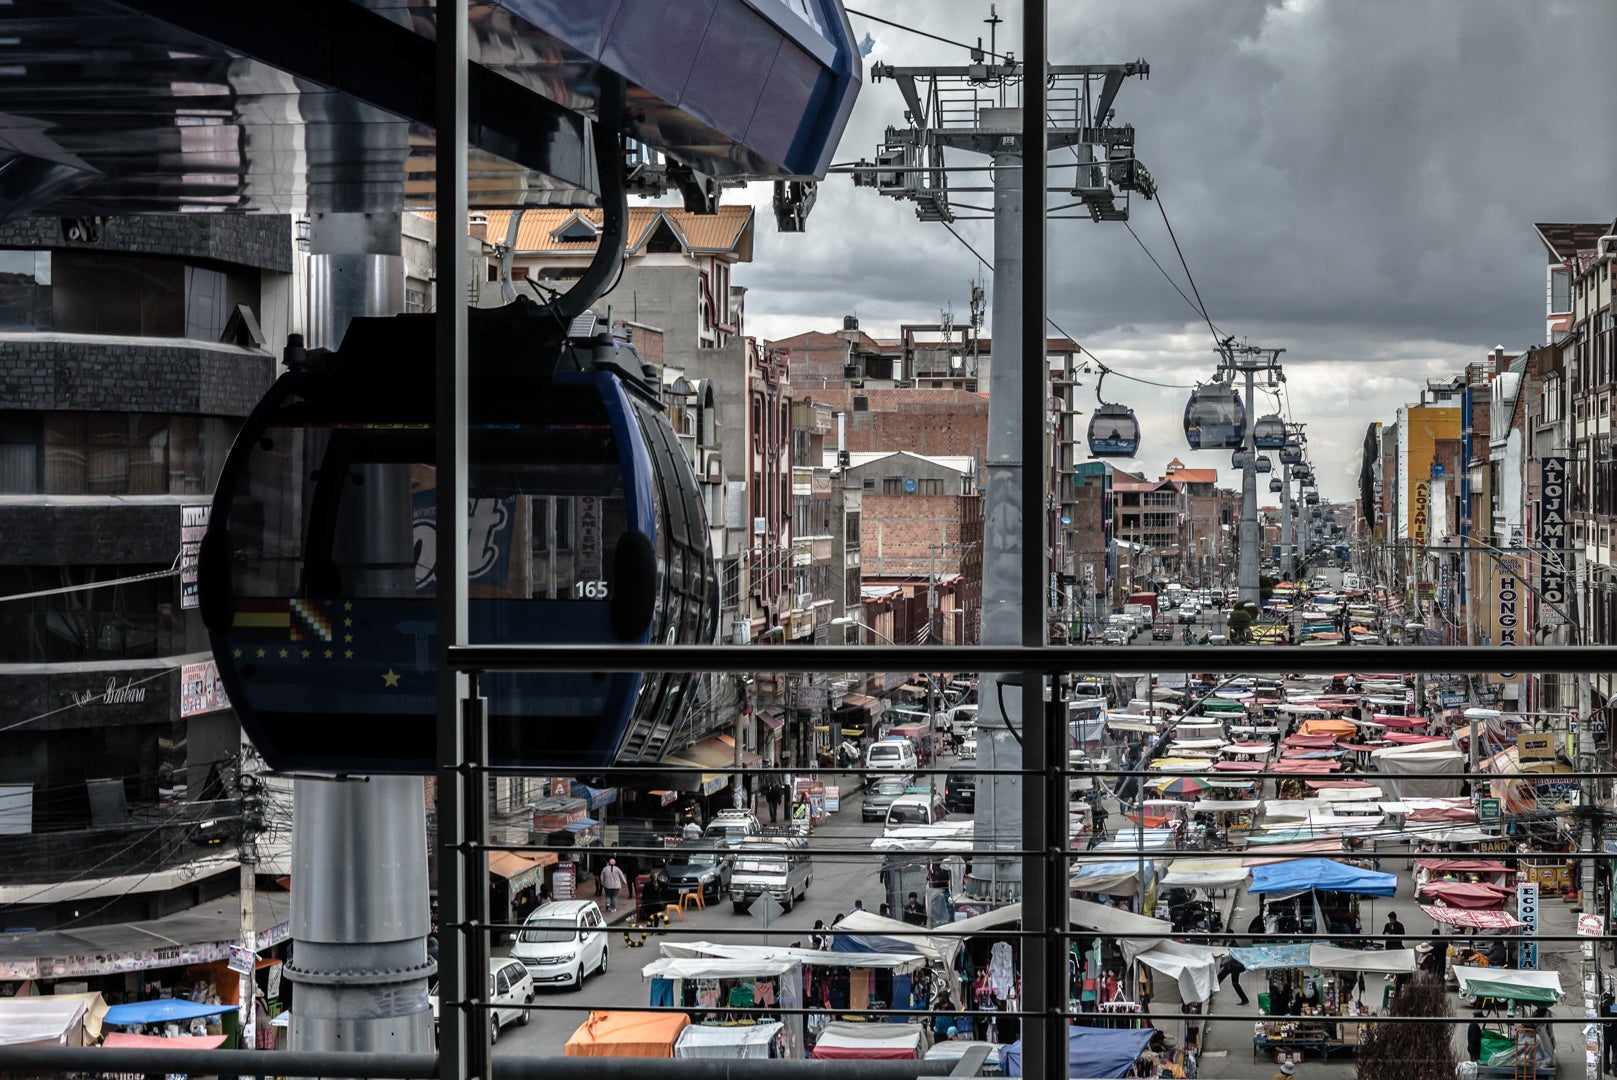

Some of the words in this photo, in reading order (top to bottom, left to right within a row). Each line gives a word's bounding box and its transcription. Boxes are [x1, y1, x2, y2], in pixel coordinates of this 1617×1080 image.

[1415, 483, 1428, 559] ALOJAMIENO
[1543, 458, 1565, 602] ALOJAMIENTO
[575, 580, 609, 599] 165
[1498, 577, 1518, 627] HONG
[103, 676, 146, 706] Barbara
[1521, 888, 1535, 968] ECOGRFÍA
[157, 950, 181, 961] BELEN
